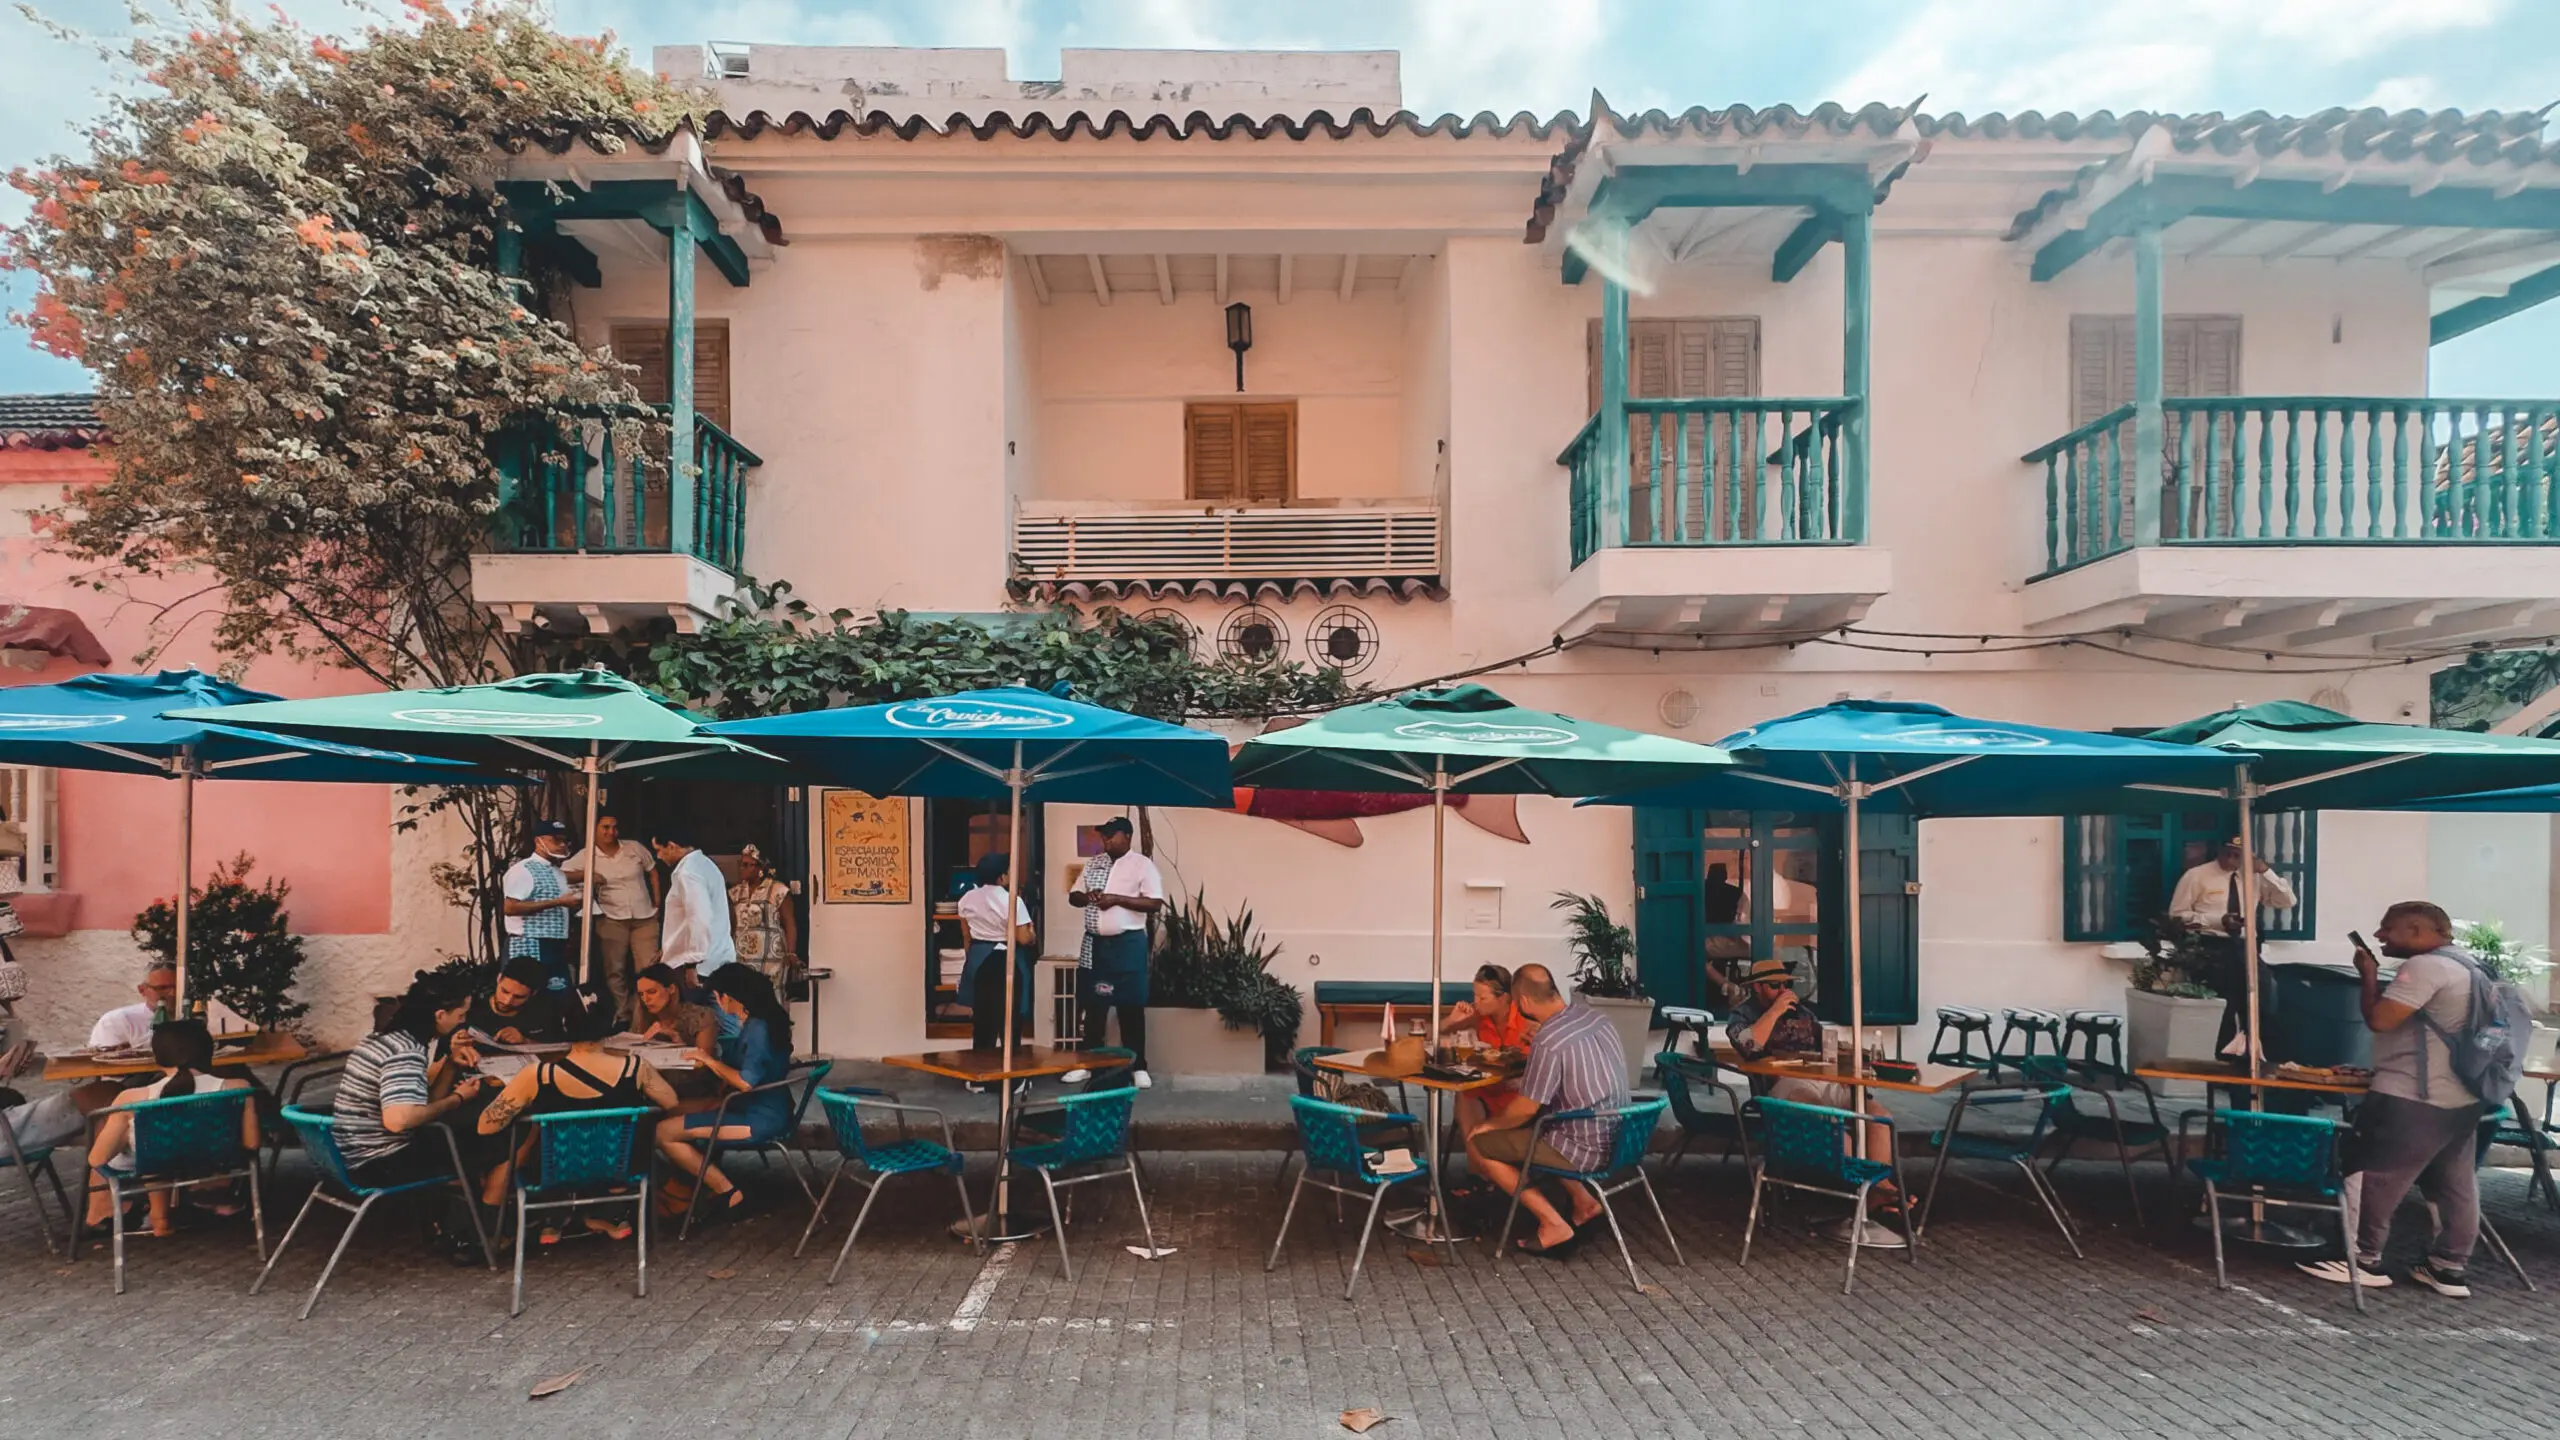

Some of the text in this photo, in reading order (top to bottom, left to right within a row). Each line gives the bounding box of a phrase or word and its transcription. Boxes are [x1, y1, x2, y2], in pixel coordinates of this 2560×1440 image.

[835, 846, 900, 856] ESPECIALIDAD
[839, 856, 897, 867] EN COMIDA
[857, 867, 885, 878] MAR
